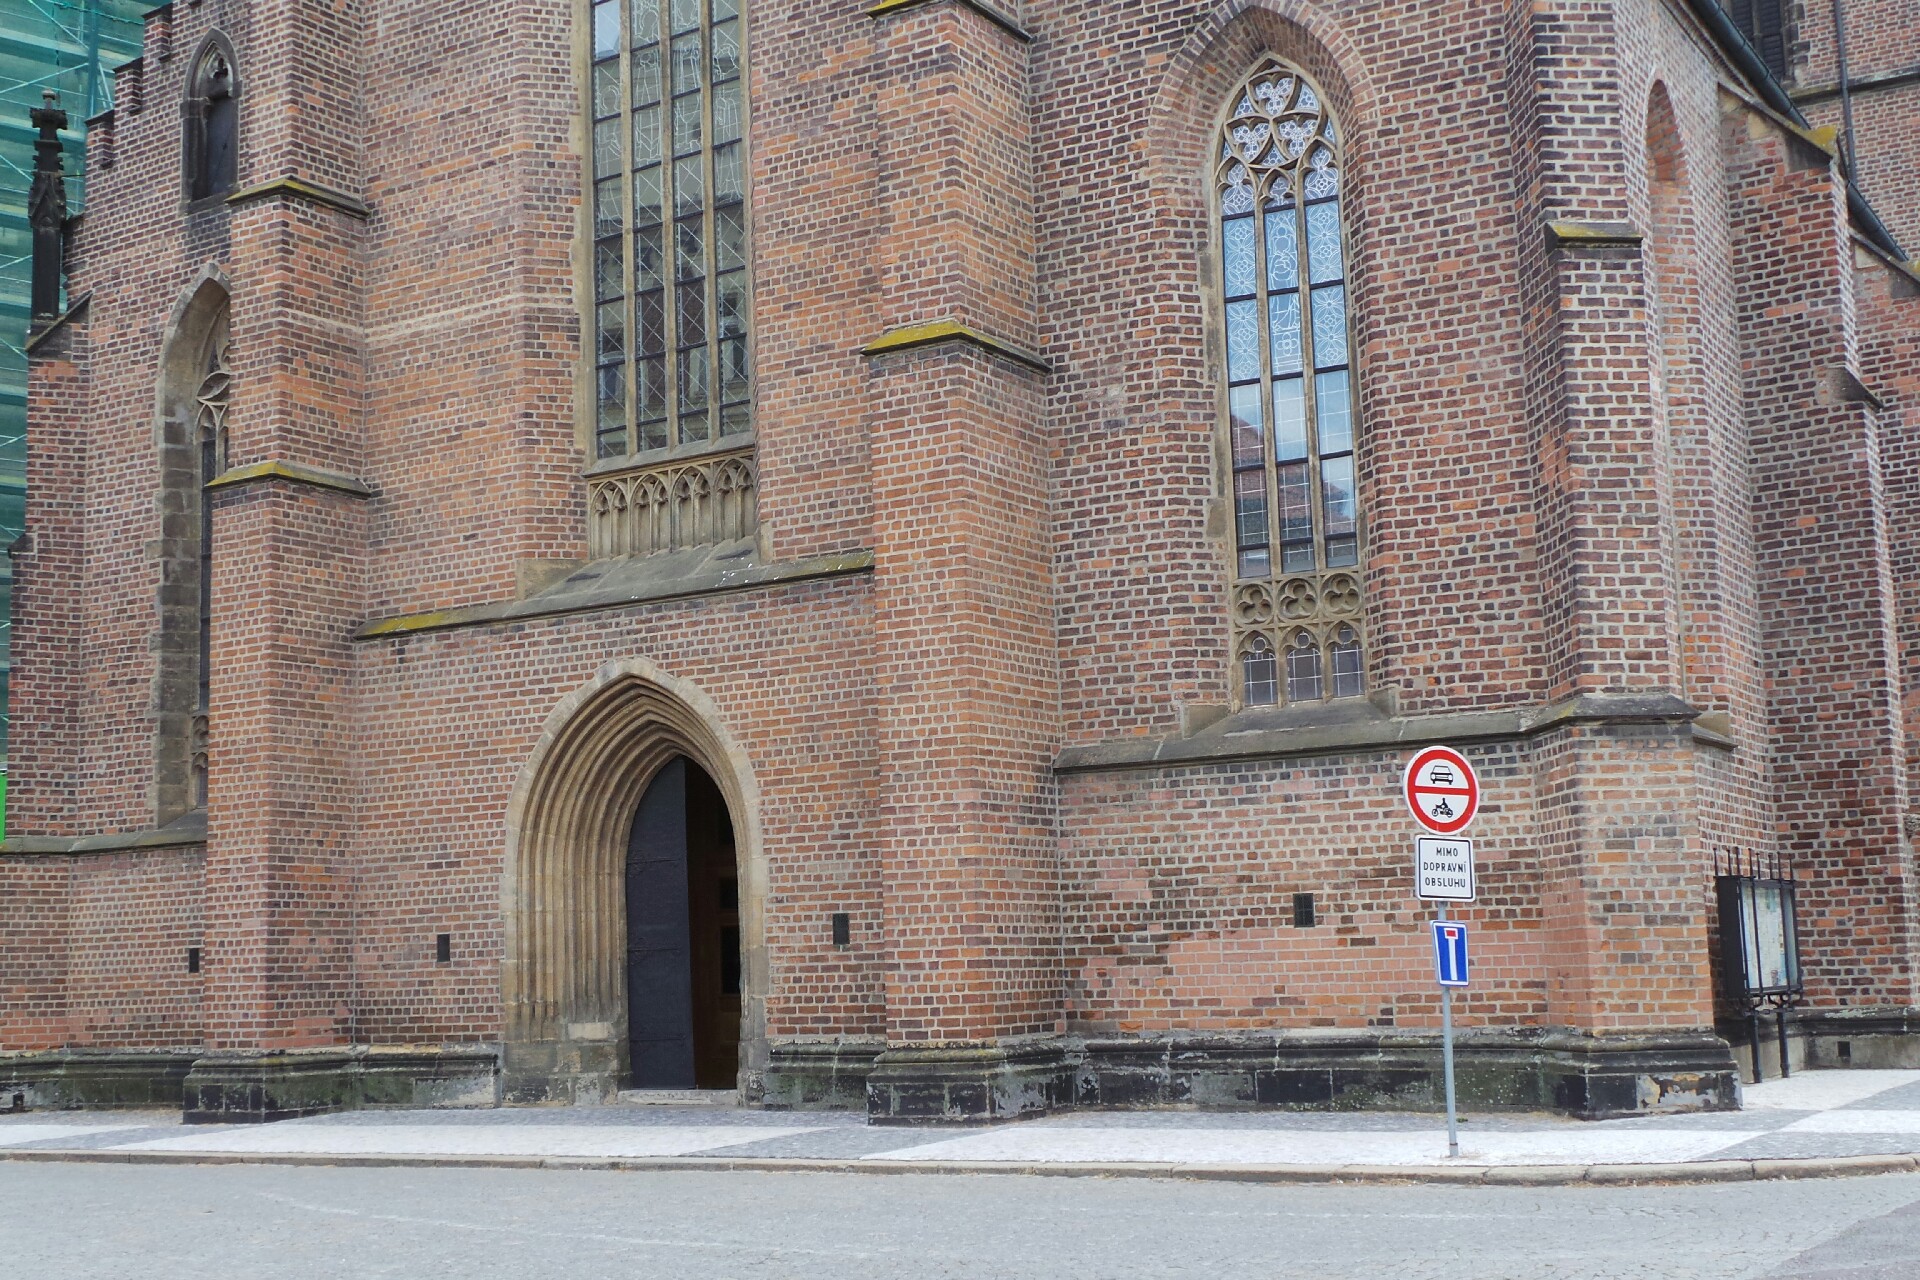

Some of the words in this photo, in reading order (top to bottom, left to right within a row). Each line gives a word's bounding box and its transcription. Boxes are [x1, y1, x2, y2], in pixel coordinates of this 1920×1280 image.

[1436, 847, 1458, 857] MIMO
[1423, 861, 1467, 873] DOPRAVNÍ
[1425, 877, 1466, 888] OBSLUHU
